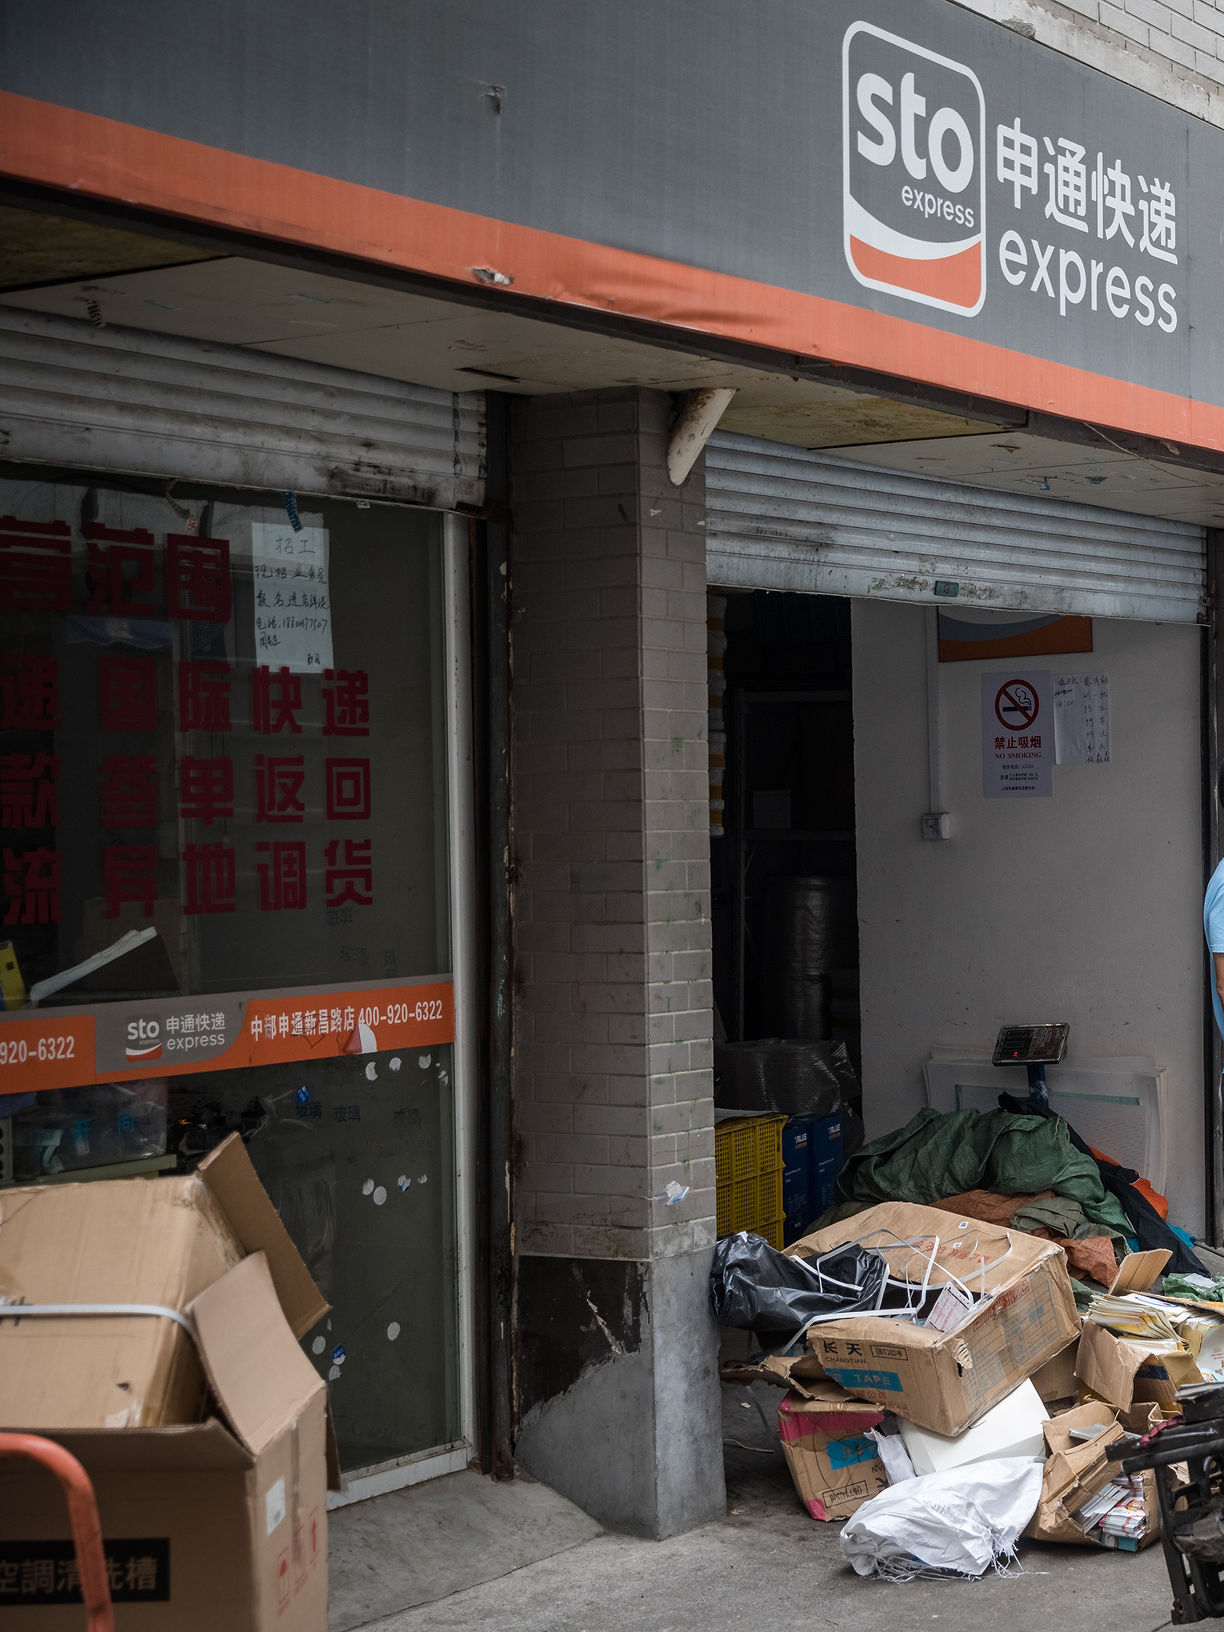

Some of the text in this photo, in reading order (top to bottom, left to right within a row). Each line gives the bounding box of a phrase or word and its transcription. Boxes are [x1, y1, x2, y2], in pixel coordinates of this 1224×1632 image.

[857, 72, 974, 193] sto
[901, 185, 975, 228] express
[997, 117, 1178, 265] 申通快递
[999, 230, 1178, 333] express
[98, 656, 370, 737] 国际快递
[994, 735, 1042, 750] 禁止吸烟
[127, 1018, 160, 1040] sto
[166, 1011, 226, 1035] 申通快递
[251, 999, 443, 1041] 中部申通新昌路店 400-920-6322
[166, 1033, 225, 1052] express
[823, 1341, 863, 1356] 长天
[855, 1374, 891, 1386] TAPE
